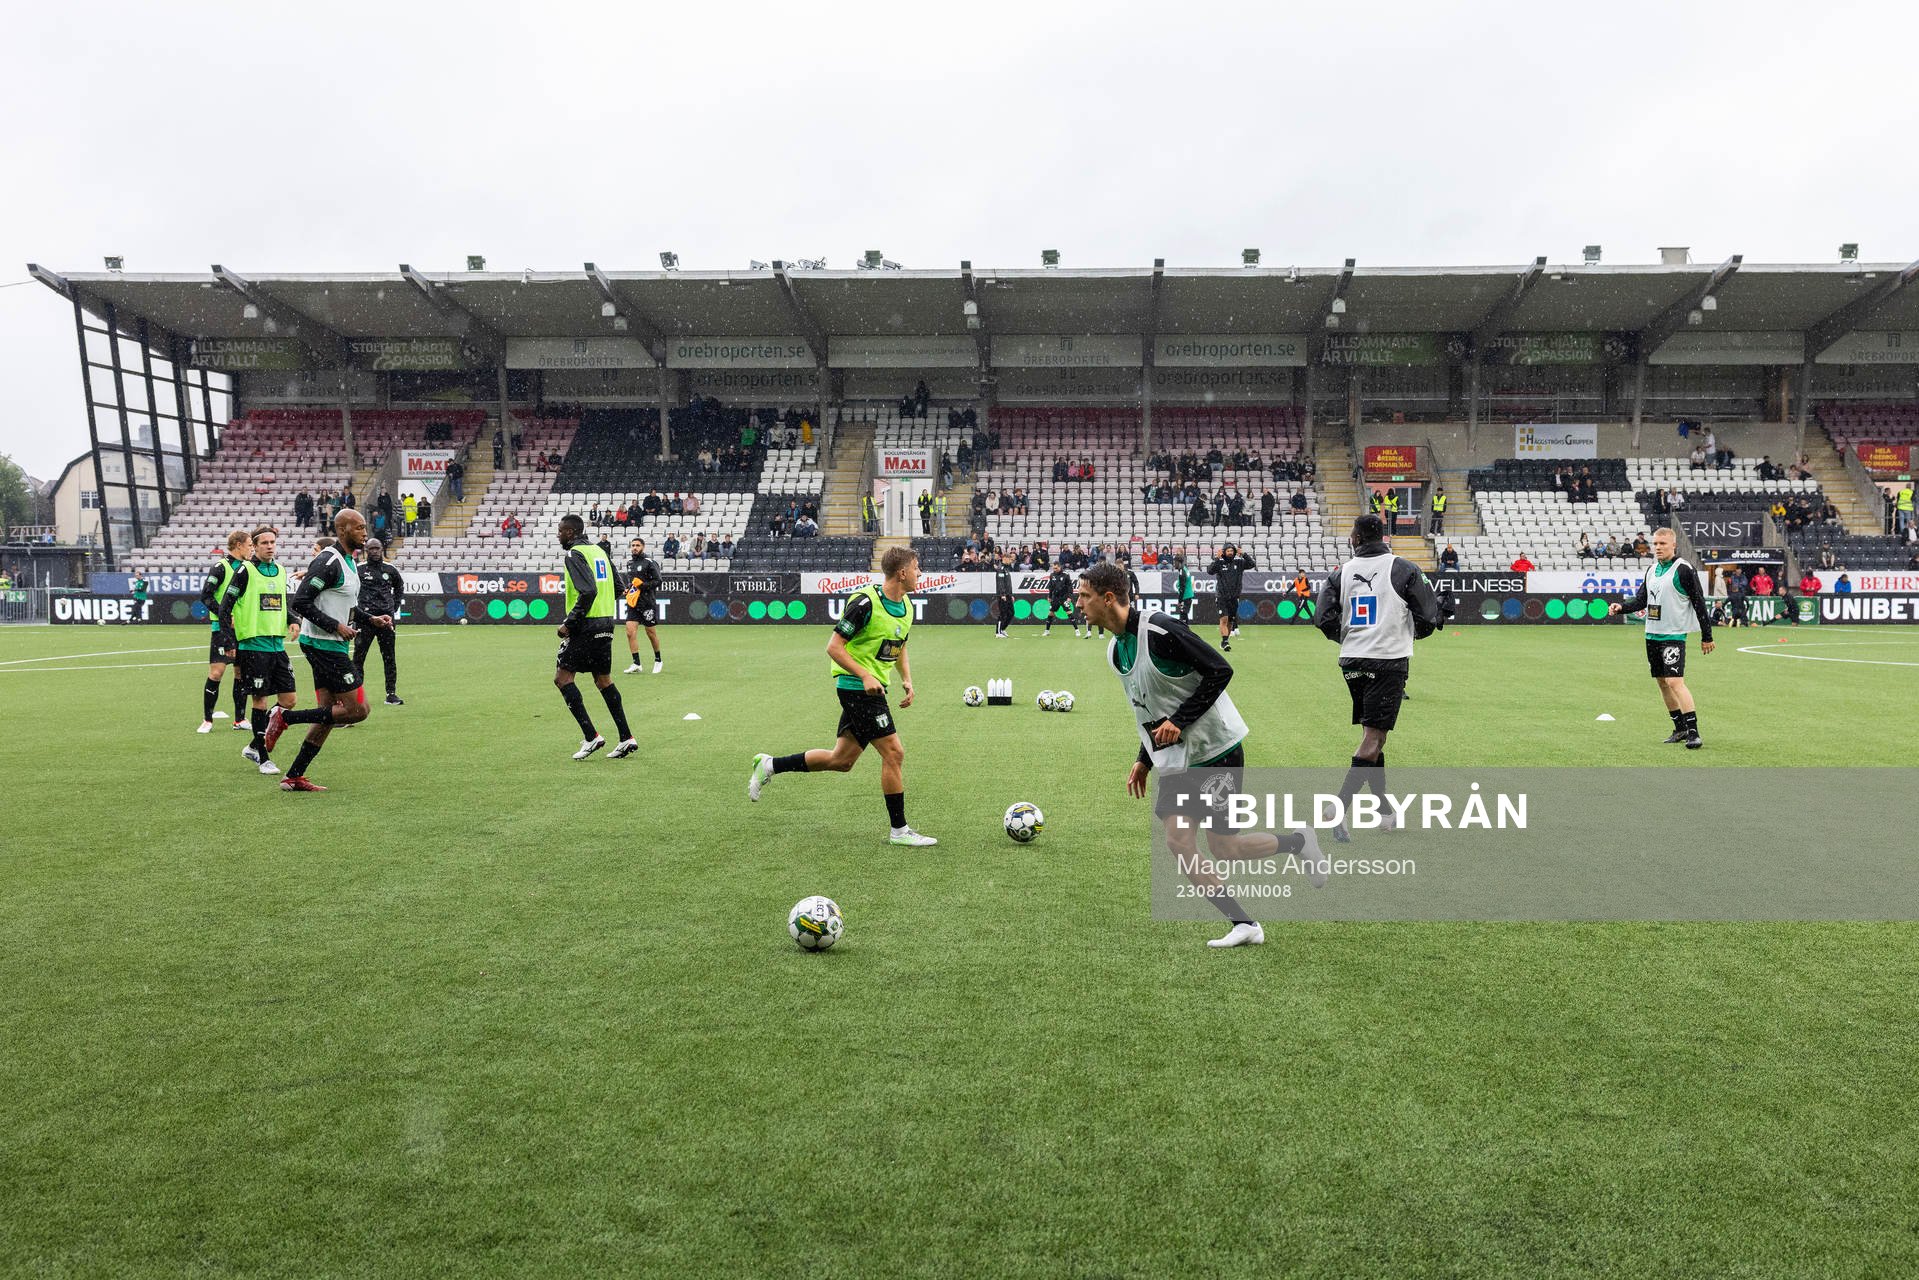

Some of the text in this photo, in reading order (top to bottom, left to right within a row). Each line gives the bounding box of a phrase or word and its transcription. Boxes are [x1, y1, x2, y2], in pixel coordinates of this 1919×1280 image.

[884, 457, 926, 470] MAXI
[1681, 521, 1756, 537] ERNST
[459, 576, 528, 594] laget.se
[733, 580, 777, 593] TYBBLE
[817, 575, 873, 594] Radiator
[914, 574, 957, 593] adiator
[1860, 576, 1919, 590] BEHR
